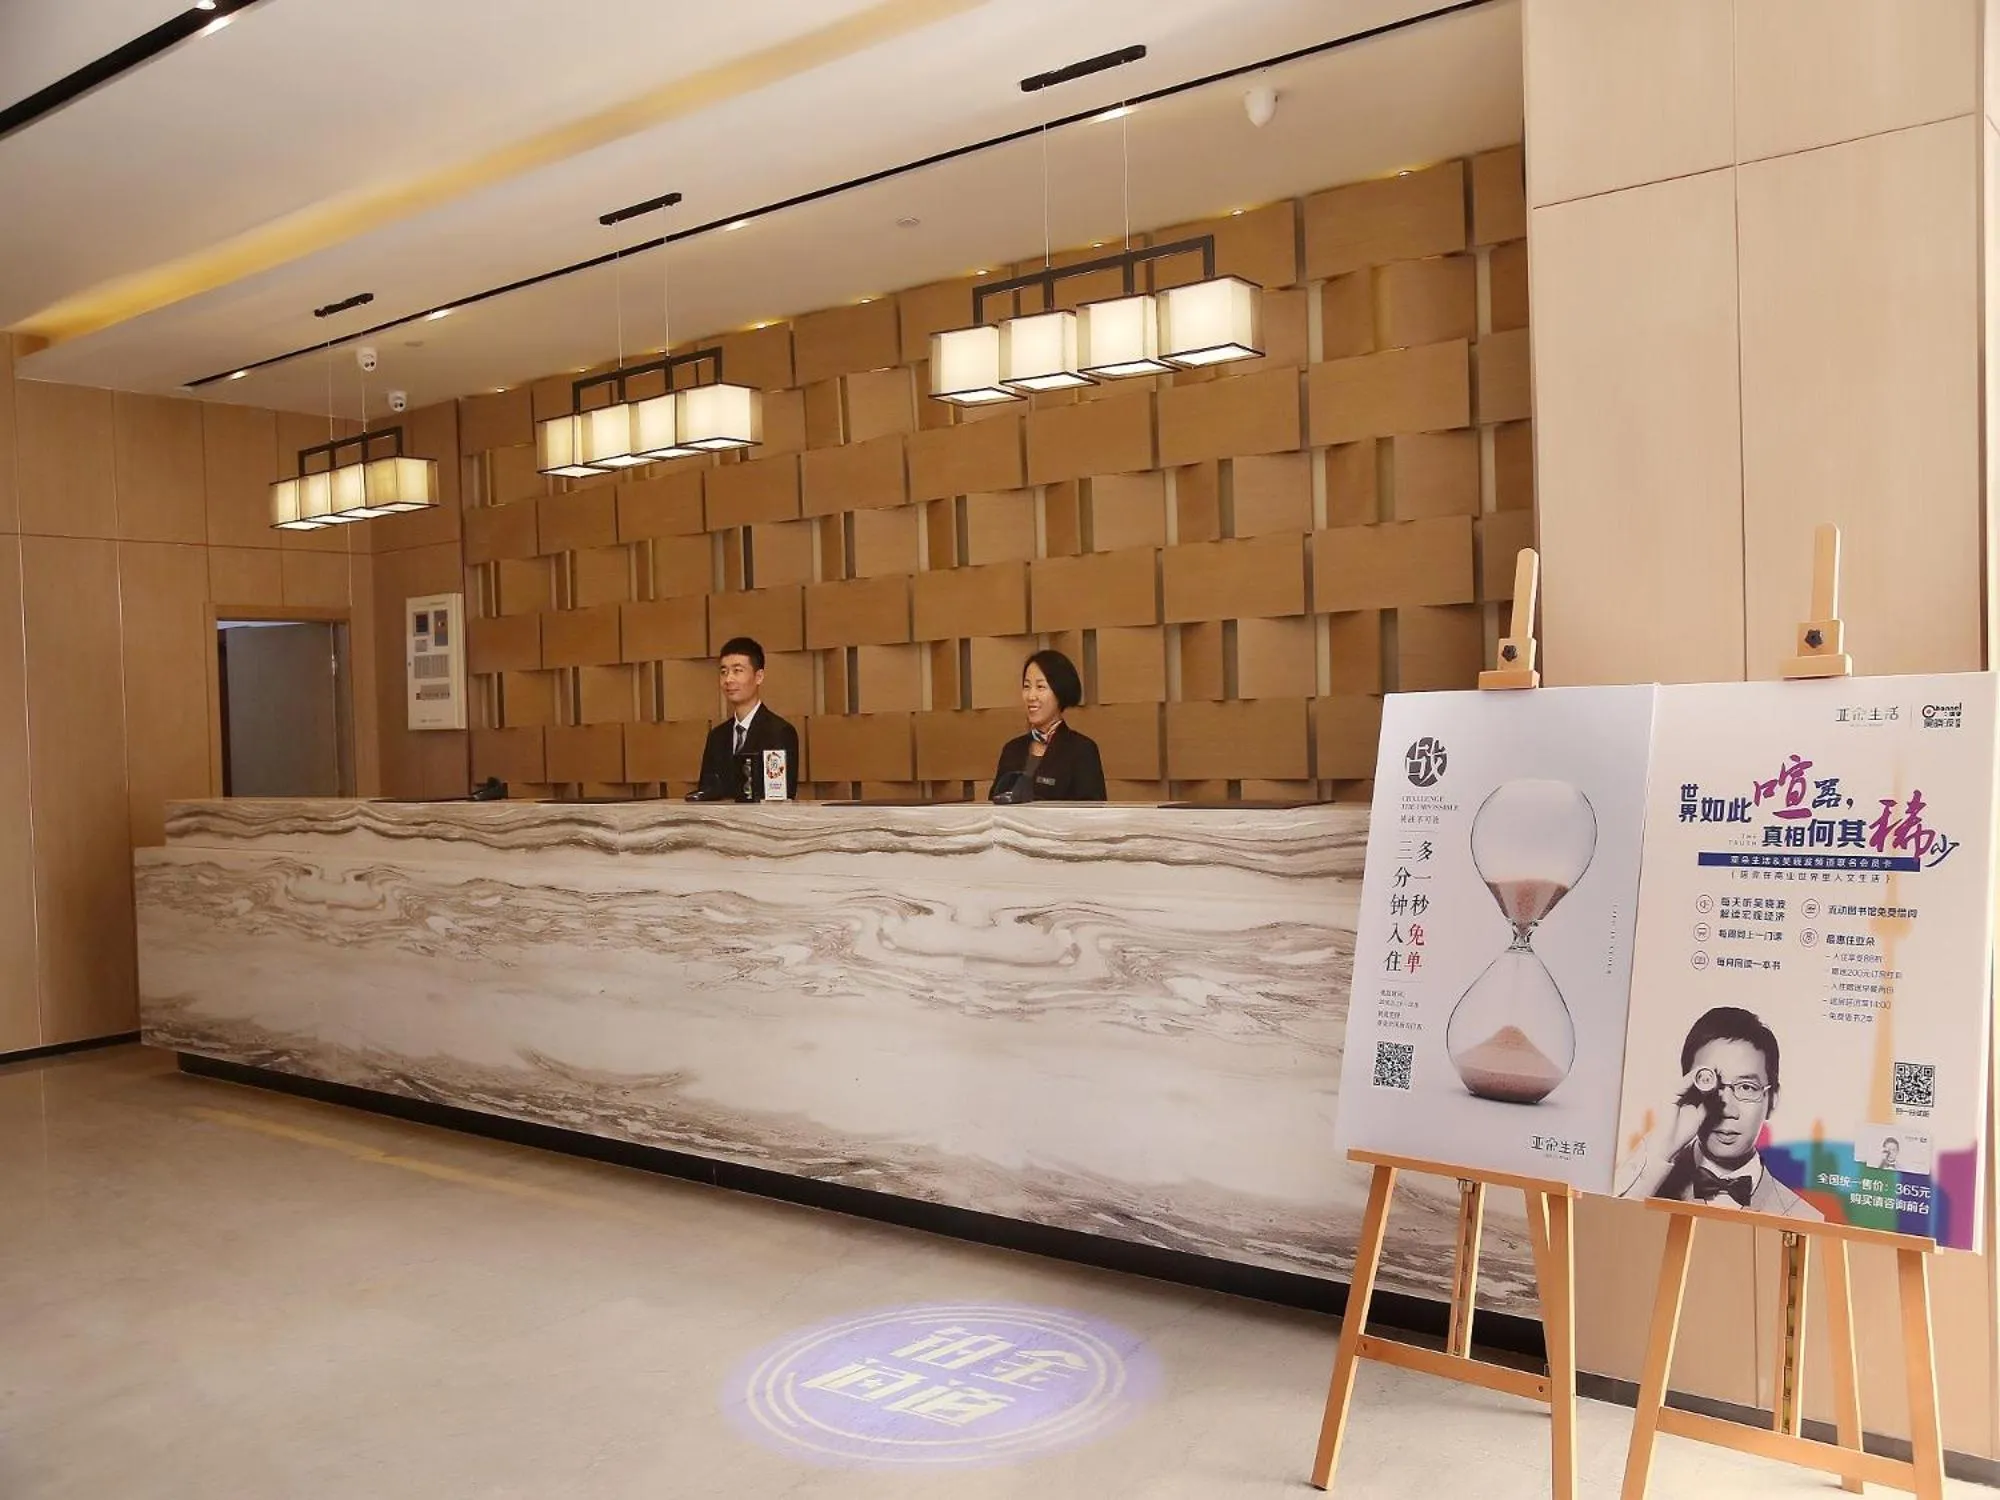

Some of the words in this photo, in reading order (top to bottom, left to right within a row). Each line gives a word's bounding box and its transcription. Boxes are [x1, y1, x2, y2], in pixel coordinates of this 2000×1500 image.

[1895, 1184, 1932, 1199] 365元
[1849, 1192, 1930, 1215] 购买请咨询前台
